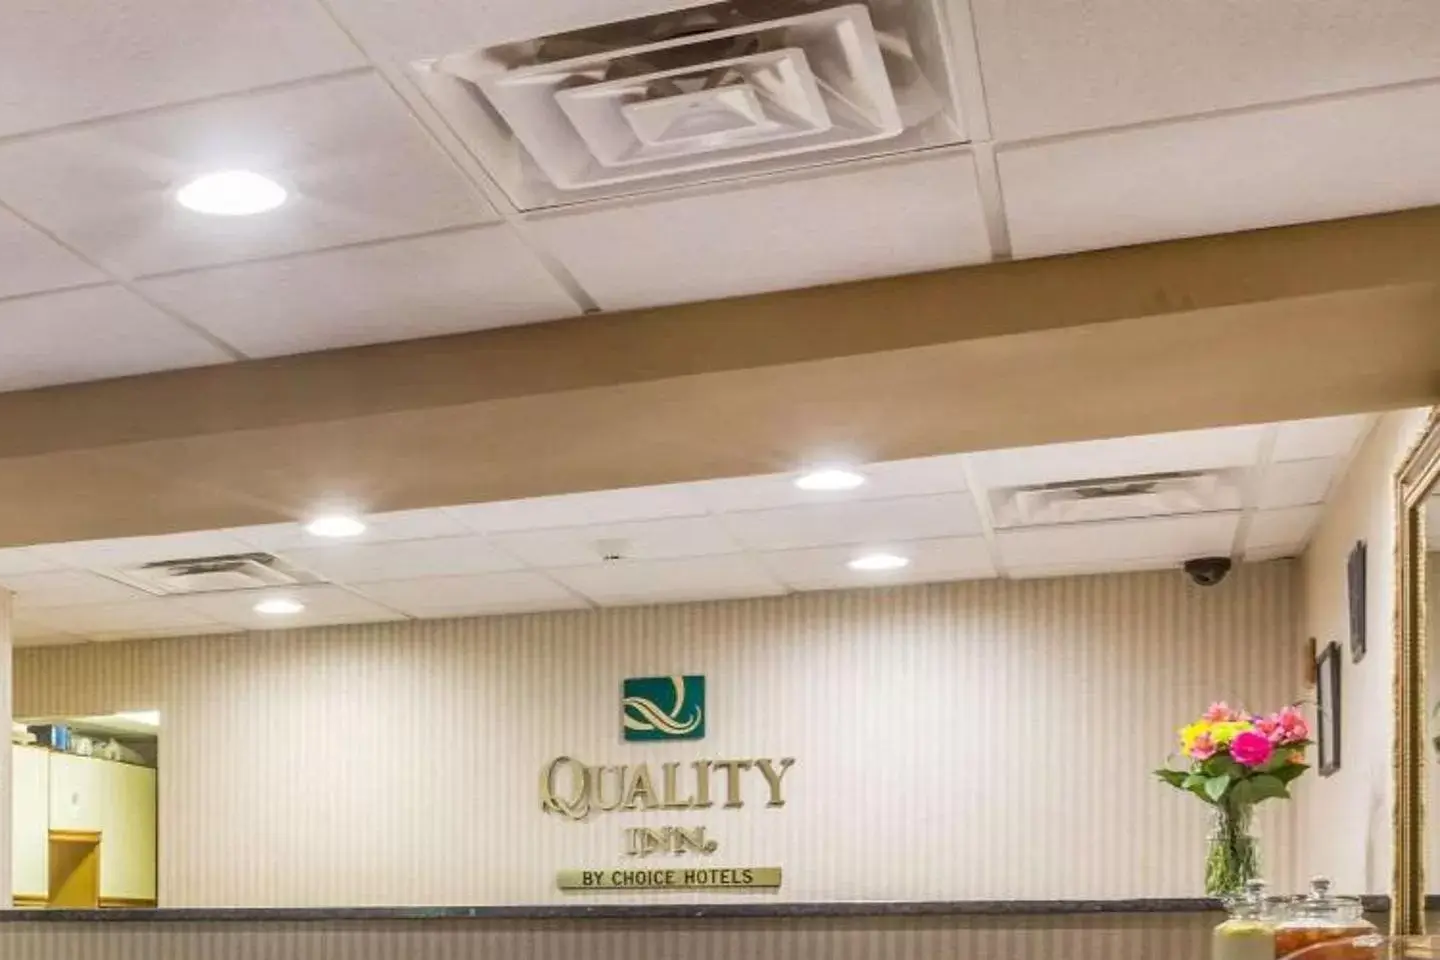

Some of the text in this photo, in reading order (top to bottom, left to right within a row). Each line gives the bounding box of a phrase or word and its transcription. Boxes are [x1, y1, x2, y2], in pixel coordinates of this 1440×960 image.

[539, 756, 795, 821] QUALITY
[583, 869, 753, 886] BY CHOICE HOTELS
